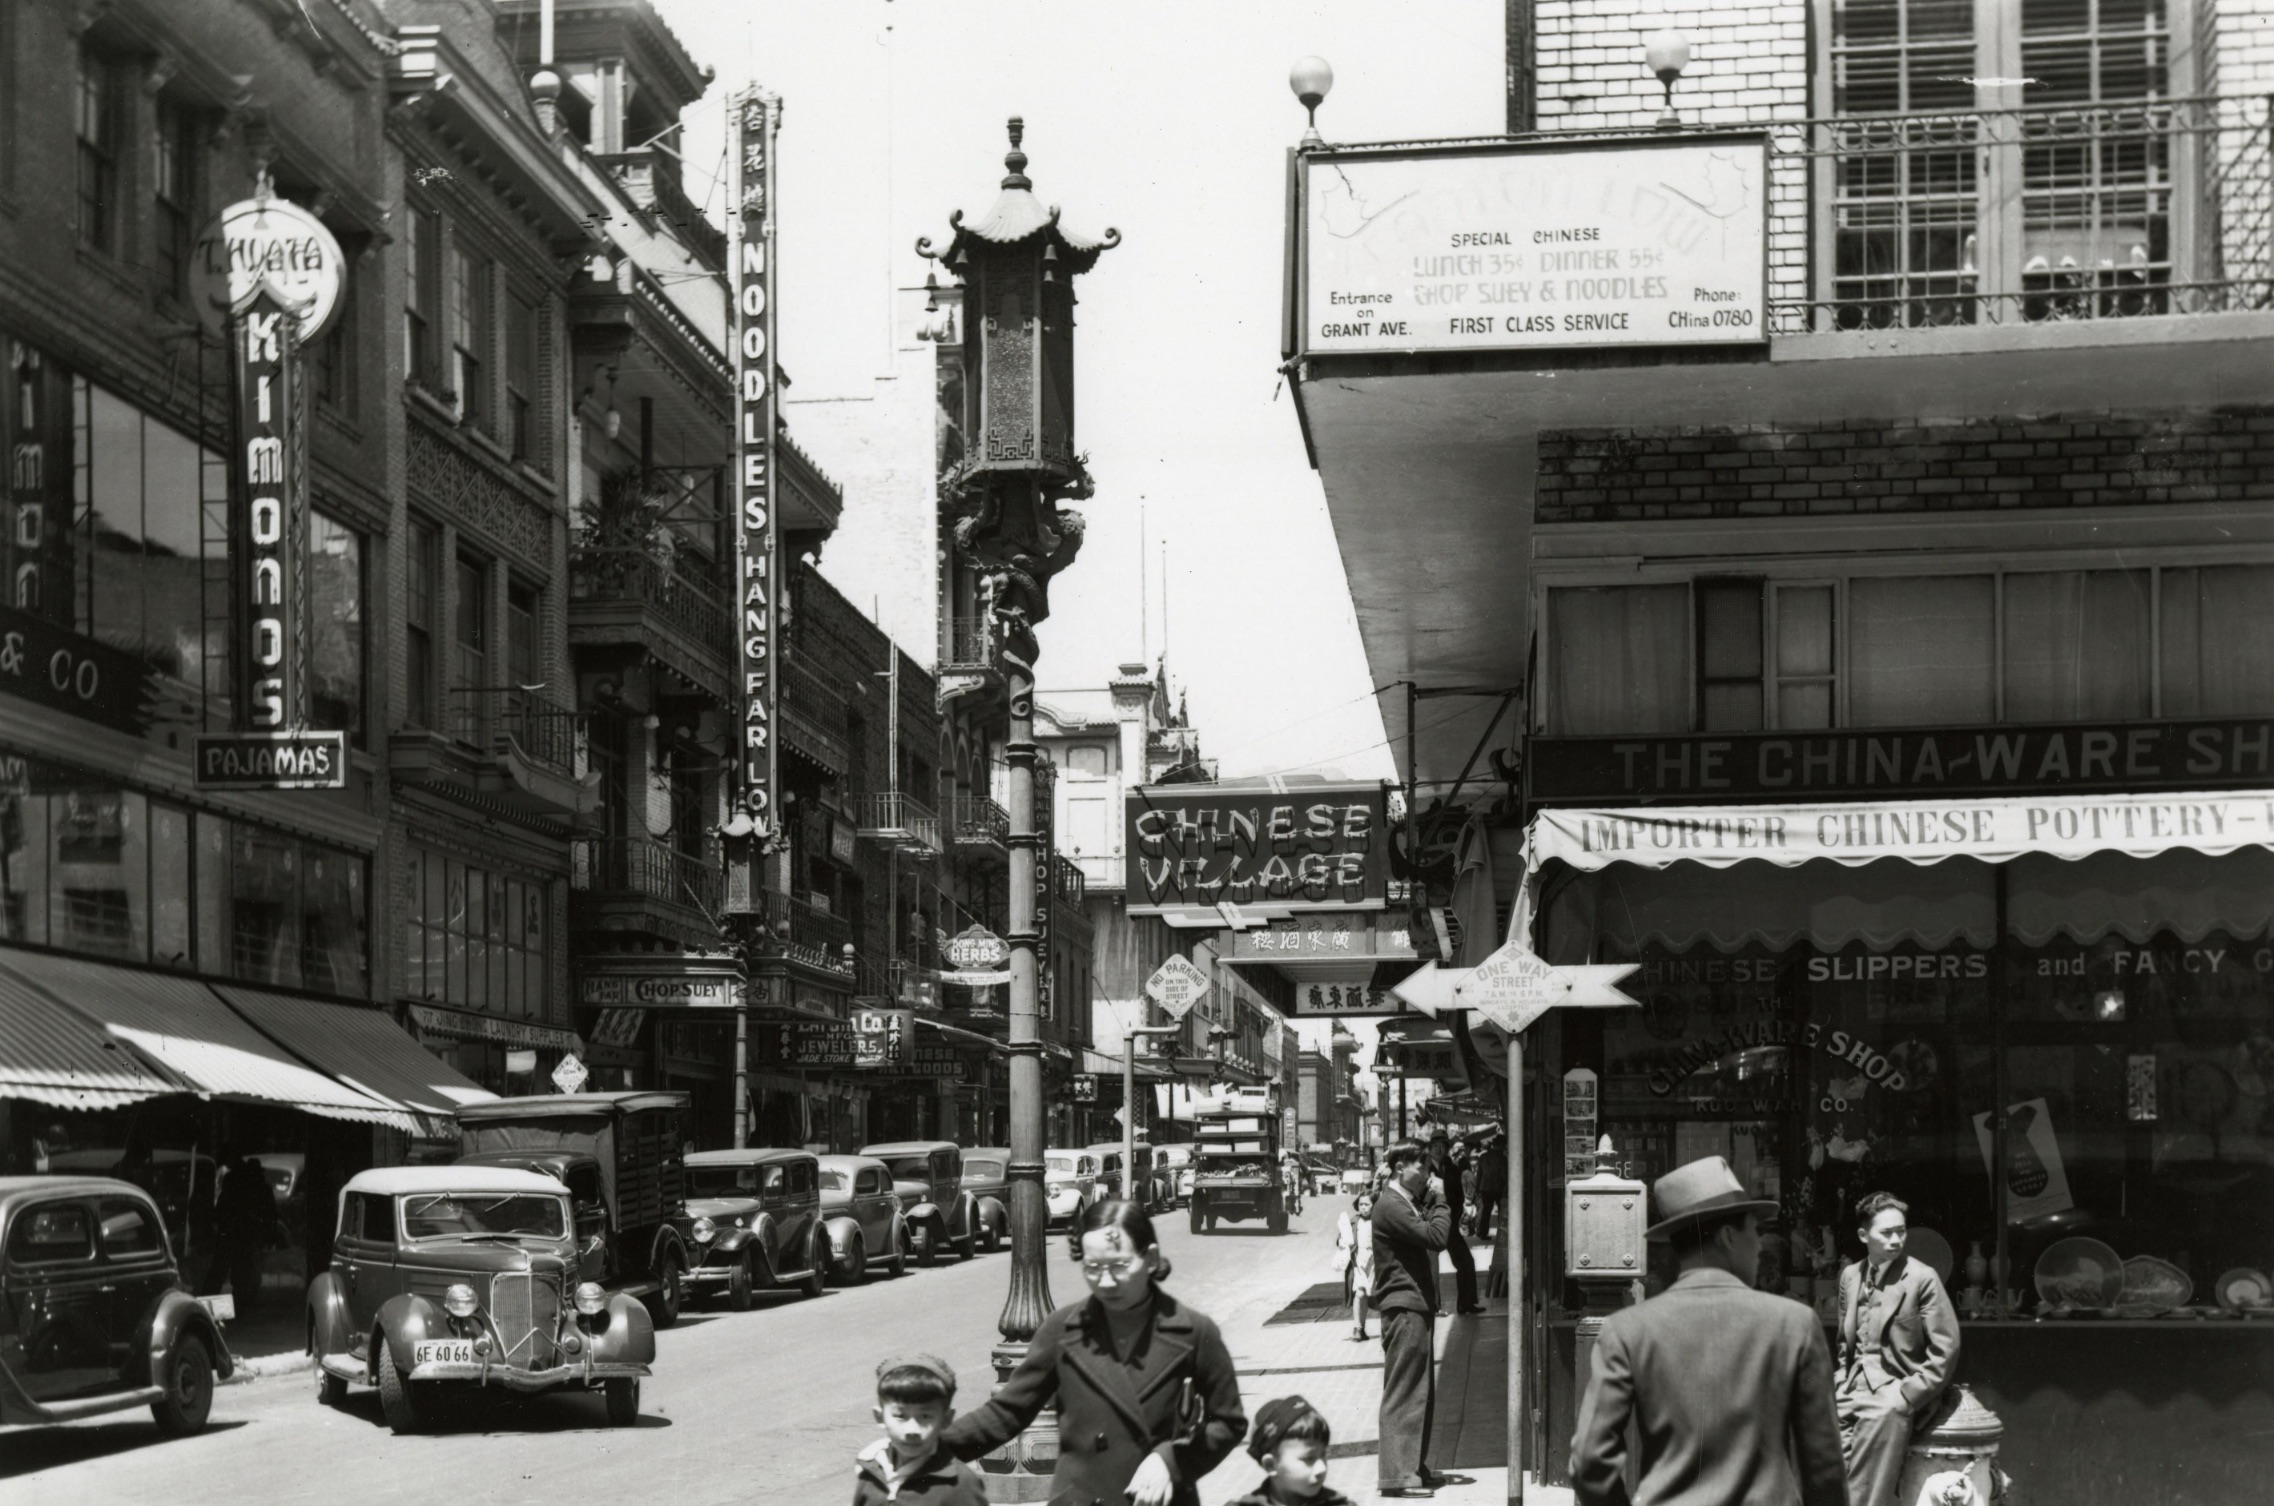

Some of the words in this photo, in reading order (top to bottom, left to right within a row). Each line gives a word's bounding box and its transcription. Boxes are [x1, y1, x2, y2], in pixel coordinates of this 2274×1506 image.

[1451, 232, 1512, 248] SPECIAL
[1533, 227, 1601, 244] CHINESE
[1413, 254, 1484, 279] LUNCH
[1488, 254, 1524, 277] 35¢
[1540, 248, 1620, 274] DINNER
[1628, 248, 1666, 271] 55¢
[1330, 291, 1394, 306] Entrance
[1413, 283, 1470, 307] CHOP
[1478, 280, 1534, 304] SUEY
[1539, 279, 1557, 302] &
[1565, 275, 1669, 301] NOODLES
[1694, 287, 1742, 305] Phone:
[1356, 308, 1375, 319] on
[1450, 316, 1495, 334] FIRST
[1506, 314, 1556, 333] CLASS
[1564, 312, 1631, 332] SERVICE
[1713, 309, 1754, 328] 0780
[1321, 323, 1371, 339] GRANT
[1379, 320, 1413, 337] AVE.
[743, 243, 767, 530] NOODLES
[745, 555, 767, 660] HANG
[0, 632, 24, 675] &
[50, 649, 99, 699] CO
[746, 672, 767, 748] FAR
[206, 744, 331, 776] PAJAMAS
[1613, 743, 1732, 790] THE
[2186, 725, 2269, 773] SH
[1135, 804, 1371, 843] CHINESE
[1580, 812, 1788, 853] IMPORTER
[1817, 807, 1996, 848] CHINESE
[1035, 829, 1048, 897] CHOP
[1139, 852, 1366, 892] VILLAGE
[1036, 907, 1048, 975] SUEY
[951, 948, 1000, 962] HERBS
[1808, 953, 1988, 982] SLIPPERS
[2037, 952, 2086, 976] and
[2113, 948, 2227, 975] FANCY
[1150, 973, 1164, 987] NO
[1166, 963, 1205, 987] PARKING
[1476, 961, 1509, 981] ONE
[1518, 961, 1553, 980] WAY
[1493, 976, 1534, 988] STREET
[634, 979, 678, 1001] CHOP
[682, 982, 718, 997] SUEY
[490, 1020, 526, 1040] LAUNDRY
[529, 1028, 565, 1044] SUPPLIES
[1489, 1010, 1512, 1031] POLICE
[797, 1054, 821, 1063] JADE
[821, 1054, 851, 1063] STONE
[913, 1062, 963, 1075] GOODS
[1825, 1029, 1906, 1093] SHOP
[1820, 1097, 1854, 1112] CO.
[416, 1346, 432, 1362] 6E
